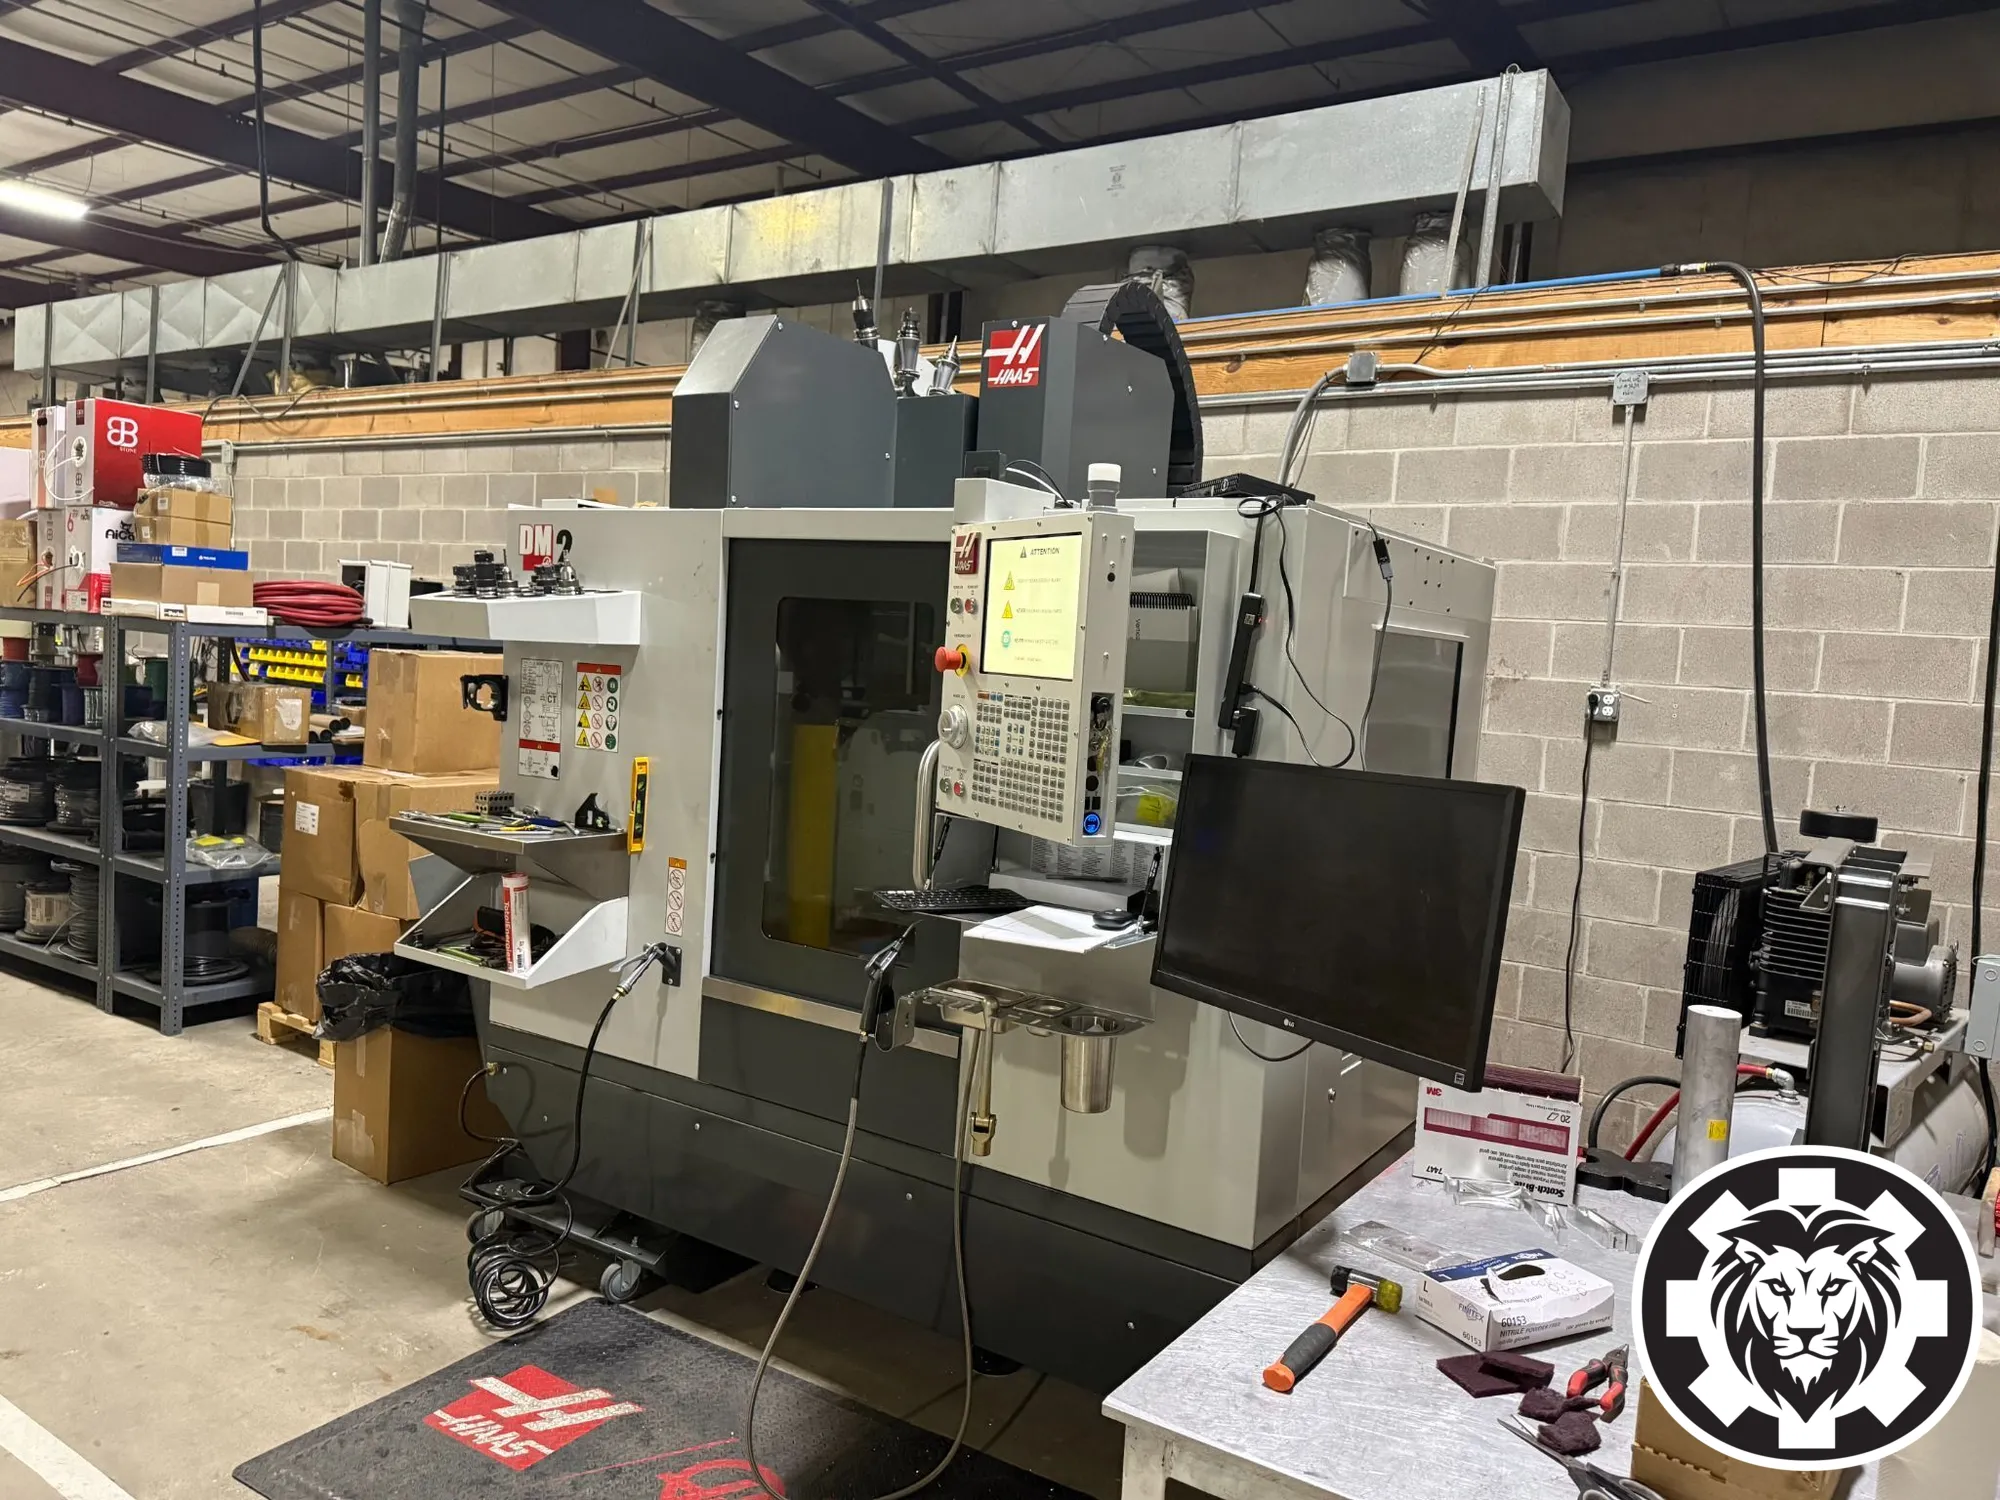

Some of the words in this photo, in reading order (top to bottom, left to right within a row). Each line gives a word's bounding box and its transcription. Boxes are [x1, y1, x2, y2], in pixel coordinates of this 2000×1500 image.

[987, 366, 1039, 385] HAAS
[518, 524, 553, 556] DM
[1030, 547, 1060, 556] ATTENTION
[955, 560, 974, 571] HAAS
[1426, 1087, 1442, 1097] 3M
[1560, 1116, 1571, 1124] 20
[1426, 1165, 1443, 1175] 7447
[1423, 1280, 1429, 1293] L
[1501, 1315, 1527, 1328] 60153
[1500, 1327, 1525, 1338] NITRILE
[1462, 1331, 1482, 1347] 60153
[433, 1409, 555, 1458] HAAS
